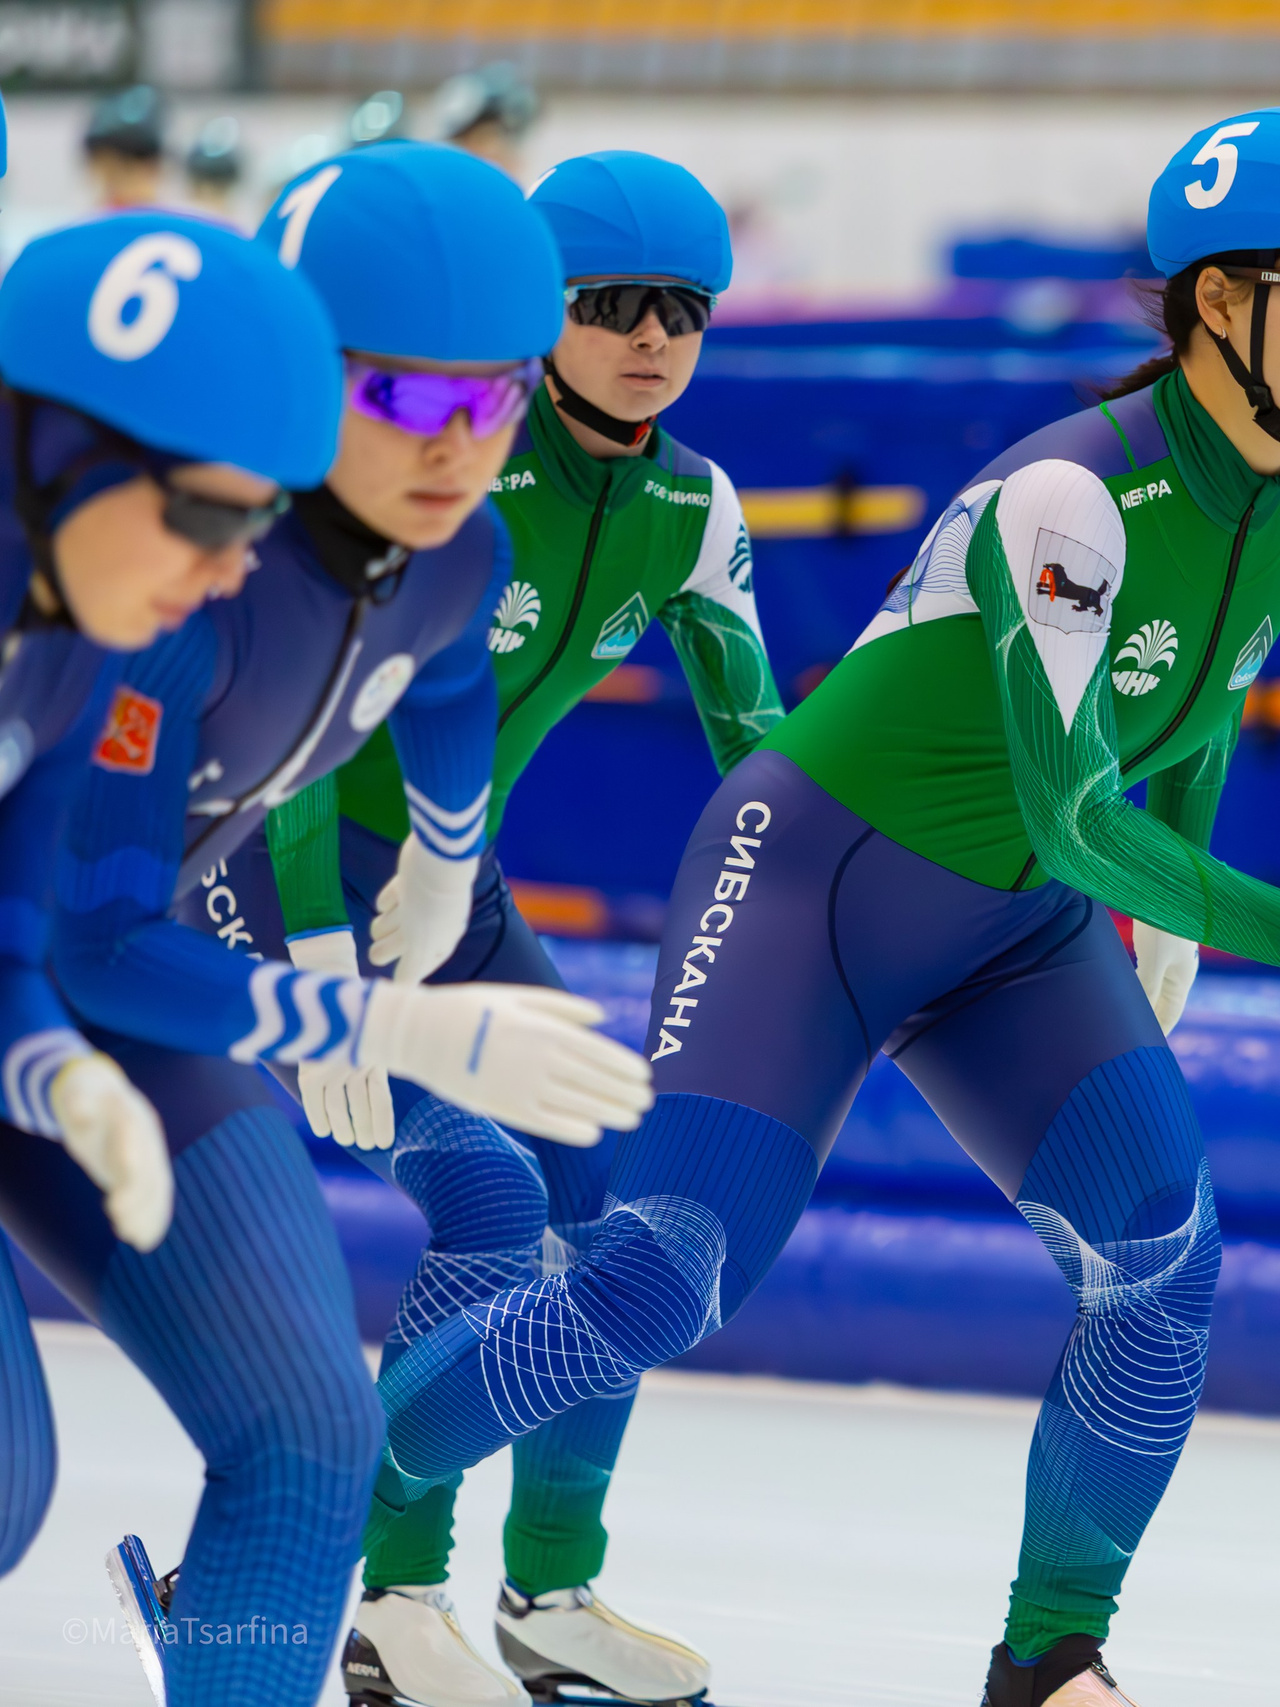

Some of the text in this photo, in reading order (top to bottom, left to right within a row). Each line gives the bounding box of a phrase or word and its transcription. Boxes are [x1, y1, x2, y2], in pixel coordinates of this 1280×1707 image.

[277, 164, 344, 271] 1
[1184, 121, 1261, 210] 5
[87, 230, 204, 363] 6
[650, 800, 772, 1063] СИБСКАНА
